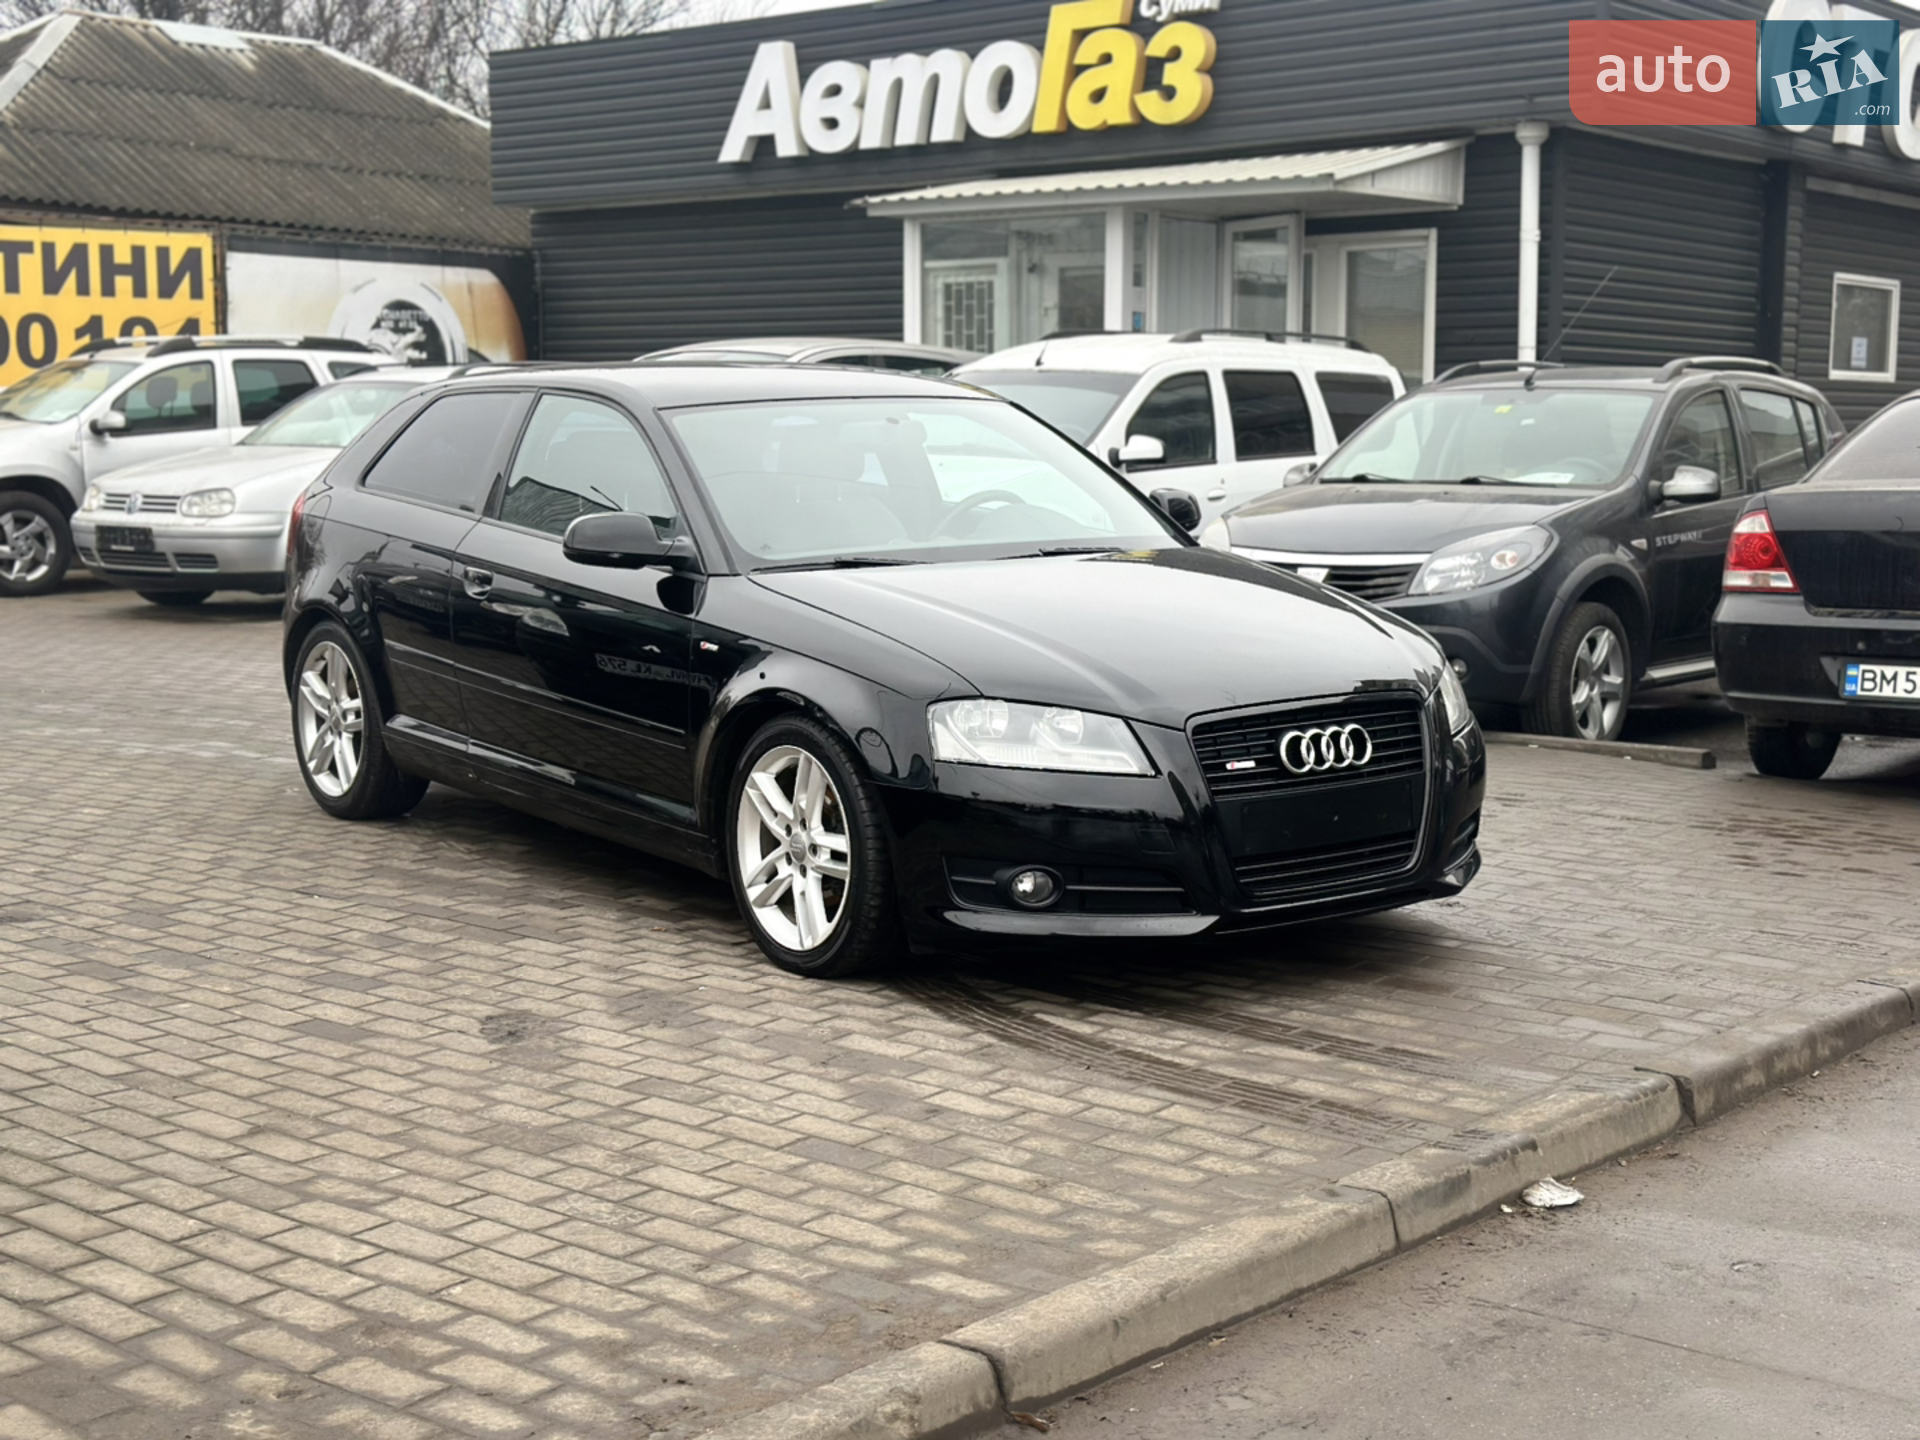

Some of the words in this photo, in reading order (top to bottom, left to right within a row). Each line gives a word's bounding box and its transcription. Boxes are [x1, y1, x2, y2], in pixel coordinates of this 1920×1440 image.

[717, 0, 1217, 164] АвтоГаз
[0, 240, 204, 301] ТИНИ
[1655, 530, 1697, 547] STEPWAY
[1860, 669, 1898, 693] BM
